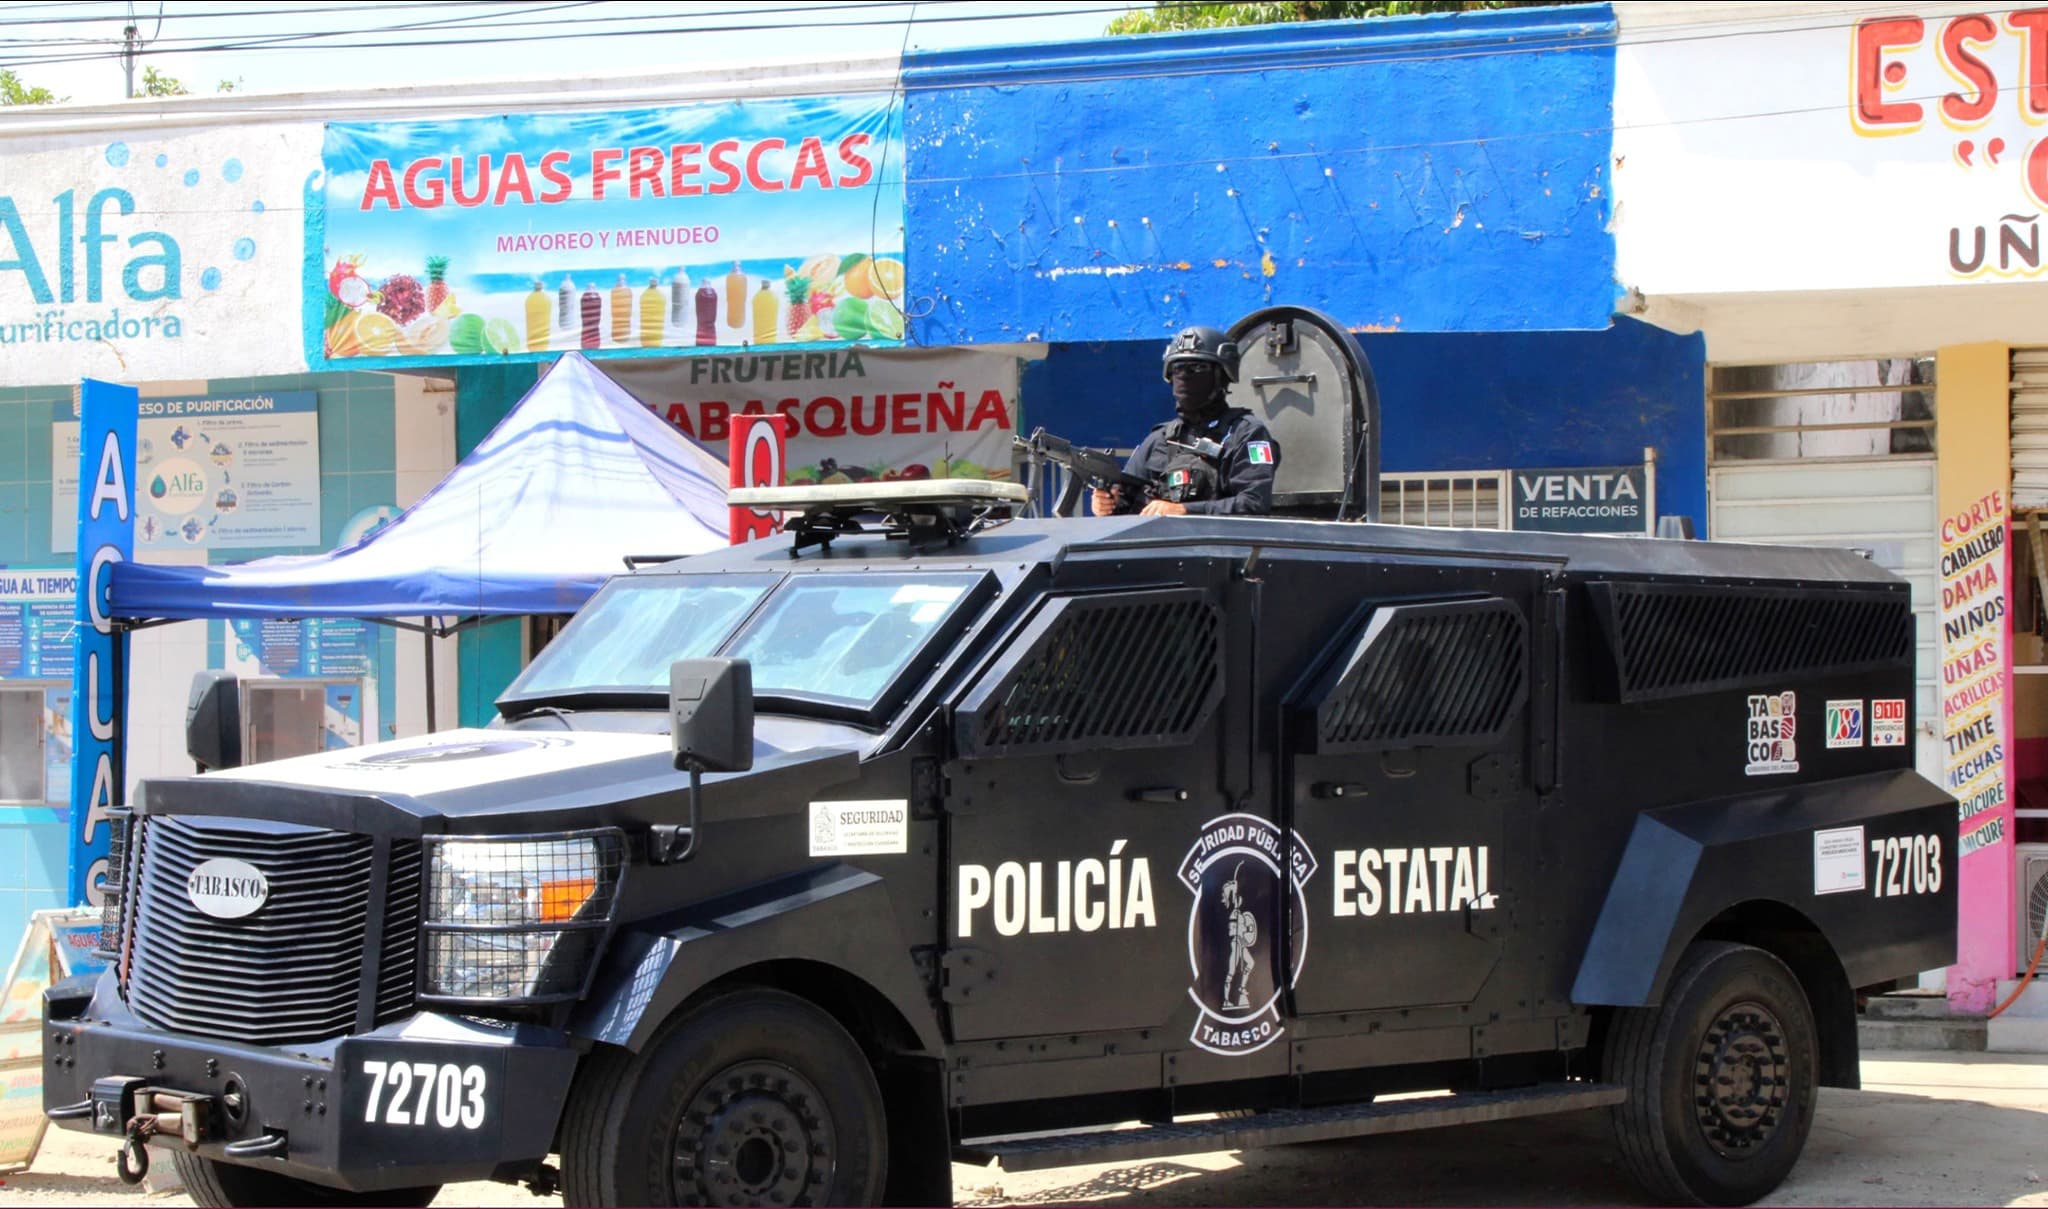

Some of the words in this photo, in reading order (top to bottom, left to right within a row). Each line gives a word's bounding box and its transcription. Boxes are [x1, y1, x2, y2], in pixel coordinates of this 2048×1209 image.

[359, 150, 571, 211] AGUAS
[592, 133, 874, 201] FRESCAS
[496, 231, 594, 253] MAYOREO
[598, 230, 610, 250] Y
[615, 225, 719, 248] MENUDEO
[167, 402, 183, 414] DE
[187, 395, 273, 413] PURIFICACIÓN
[169, 473, 203, 492] Alfa
[1518, 474, 1638, 502] VENTA
[1519, 506, 1538, 518] DE
[1542, 505, 1638, 518] REFACCIONES
[1942, 490, 2003, 542] CORTE
[1941, 525, 2004, 577] CABALLERO
[21, 578, 34, 593] AL
[37, 577, 76, 593] TIEMPO
[1943, 562, 1998, 610] DAMA
[1945, 596, 2005, 643] NIÑOS
[1943, 642, 1997, 685] UÑAS
[1875, 703, 1902, 717] 911
[1943, 672, 2005, 717] ACRILICAS
[1944, 715, 1995, 755] TINTE
[840, 810, 903, 825] SEGURIDAD
[1333, 846, 1498, 917] ESTATAL
[1871, 834, 1942, 898] 72703
[195, 875, 260, 899] TABASCO
[958, 839, 1157, 938] POLICÍA
[1203, 1021, 1271, 1046] TABASCO
[363, 1060, 486, 1129] 72703
